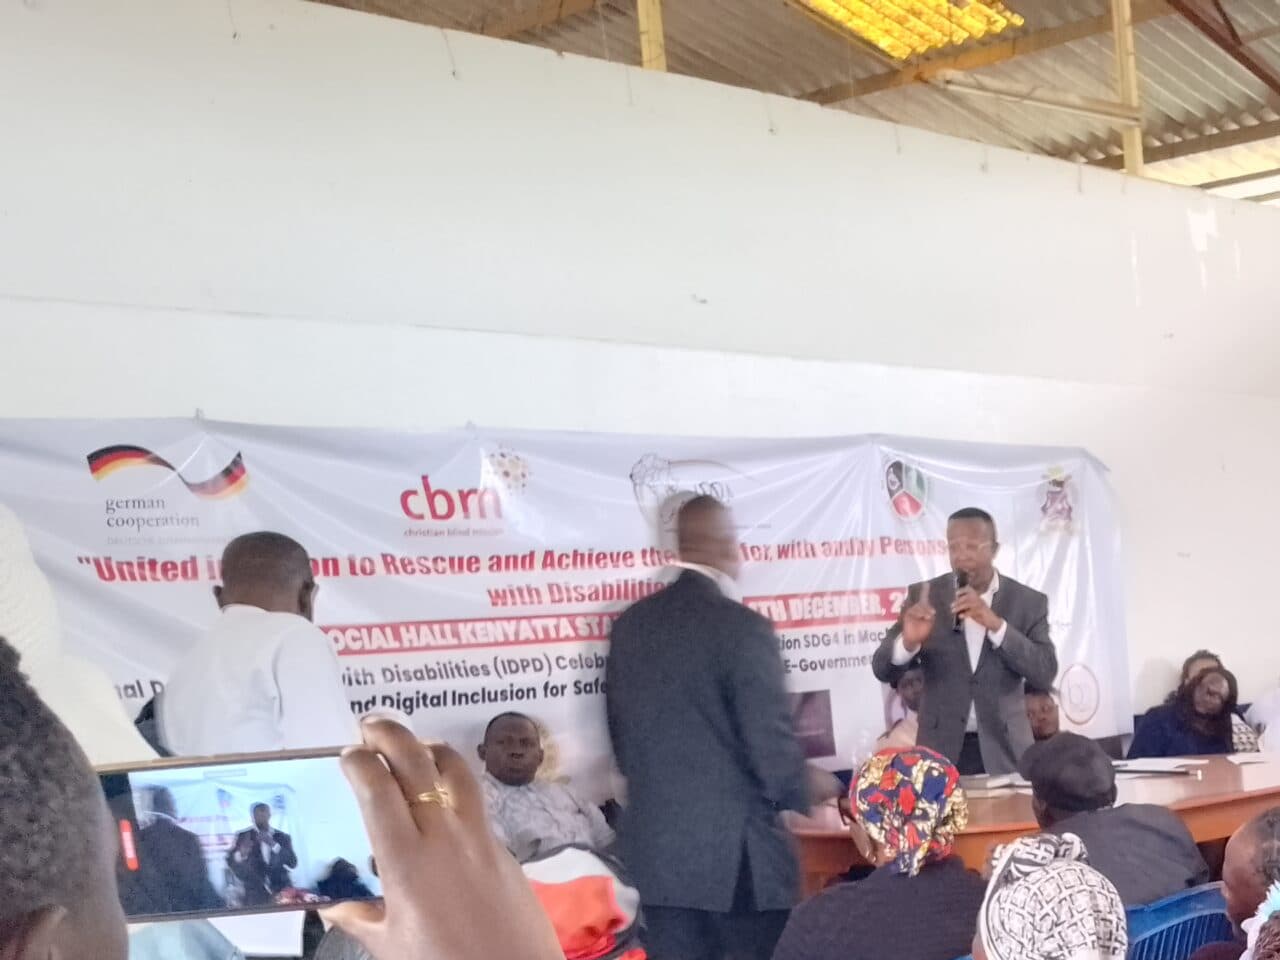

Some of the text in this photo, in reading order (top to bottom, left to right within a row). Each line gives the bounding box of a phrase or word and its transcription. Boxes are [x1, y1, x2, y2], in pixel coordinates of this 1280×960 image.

[105, 497, 165, 513] german
[106, 513, 200, 532] cooperation
[347, 554, 376, 576] to
[380, 552, 480, 576] Rescue
[488, 549, 535, 572] and
[541, 547, 634, 570] Achieve
[777, 538, 816, 559] with
[487, 577, 666, 607] with Disabilitie
[328, 626, 400, 651] OCIAL
[400, 623, 459, 648] HALL
[459, 616, 576, 645] KENYATTA
[381, 659, 491, 684] Disabilities
[494, 651, 552, 679] (IDPD)
[555, 651, 606, 670] Celeb
[381, 690, 447, 716] Digital
[452, 682, 537, 706] Inclusion
[543, 680, 567, 698] for
